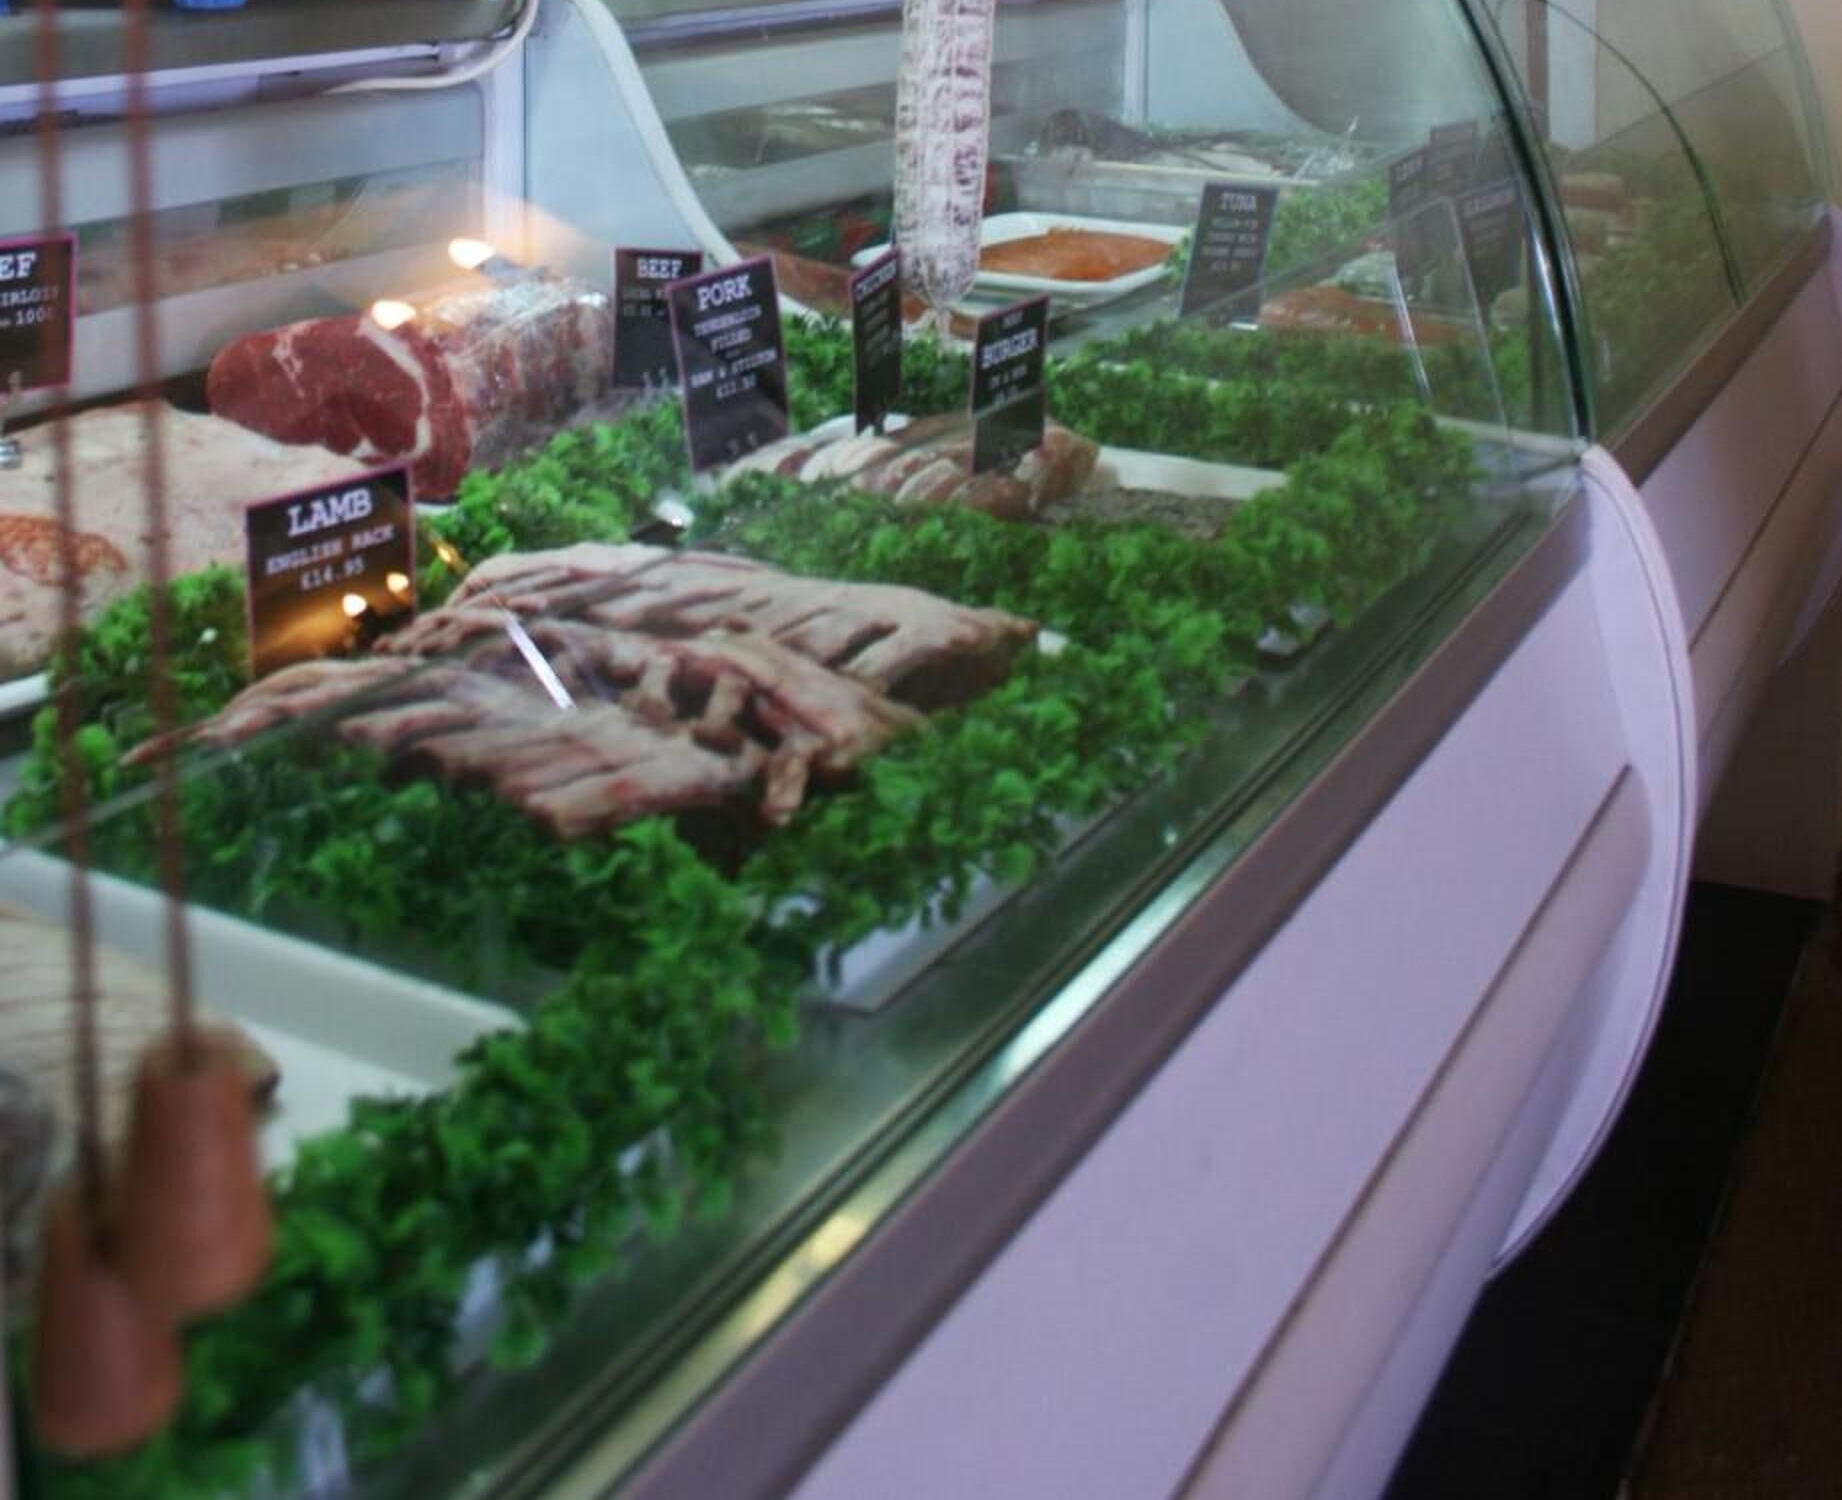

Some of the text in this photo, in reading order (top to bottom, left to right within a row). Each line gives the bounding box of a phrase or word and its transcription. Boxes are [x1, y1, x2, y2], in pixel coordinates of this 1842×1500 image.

[637, 257, 683, 279] BEEF
[697, 274, 752, 311] PORK
[288, 489, 372, 536] LAMB
[266, 523, 394, 575] ENGLISH RACK
